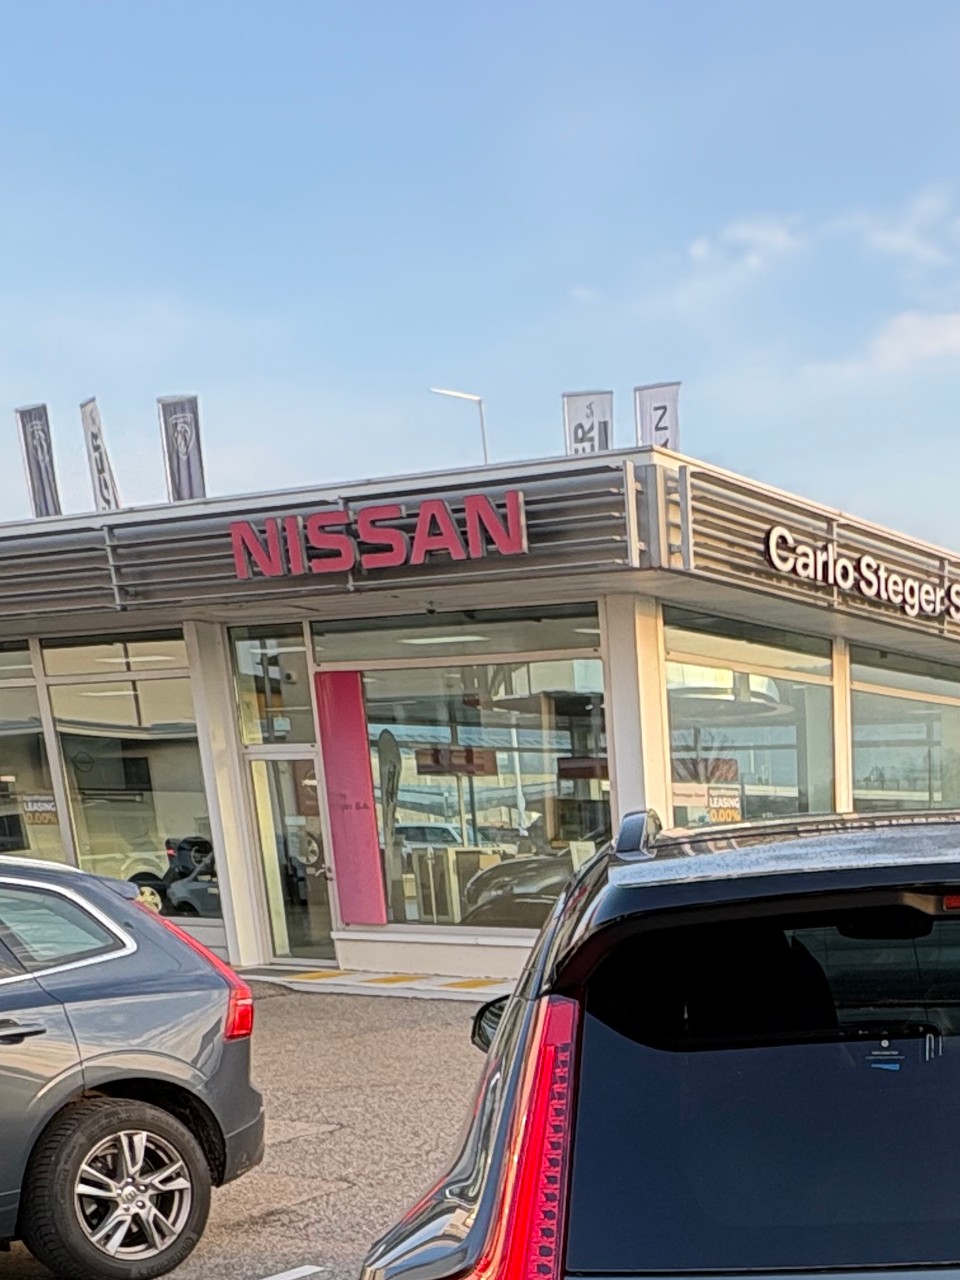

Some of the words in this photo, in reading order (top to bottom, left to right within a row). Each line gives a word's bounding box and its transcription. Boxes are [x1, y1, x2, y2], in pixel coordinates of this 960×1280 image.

[229, 490, 525, 579] NISSAN
[766, 526, 855, 590] Carlo
[858, 555, 946, 617] Steger
[24, 802, 56, 811] LEASING
[709, 796, 740, 808] LEASING
[710, 808, 741, 822] 0.00%
